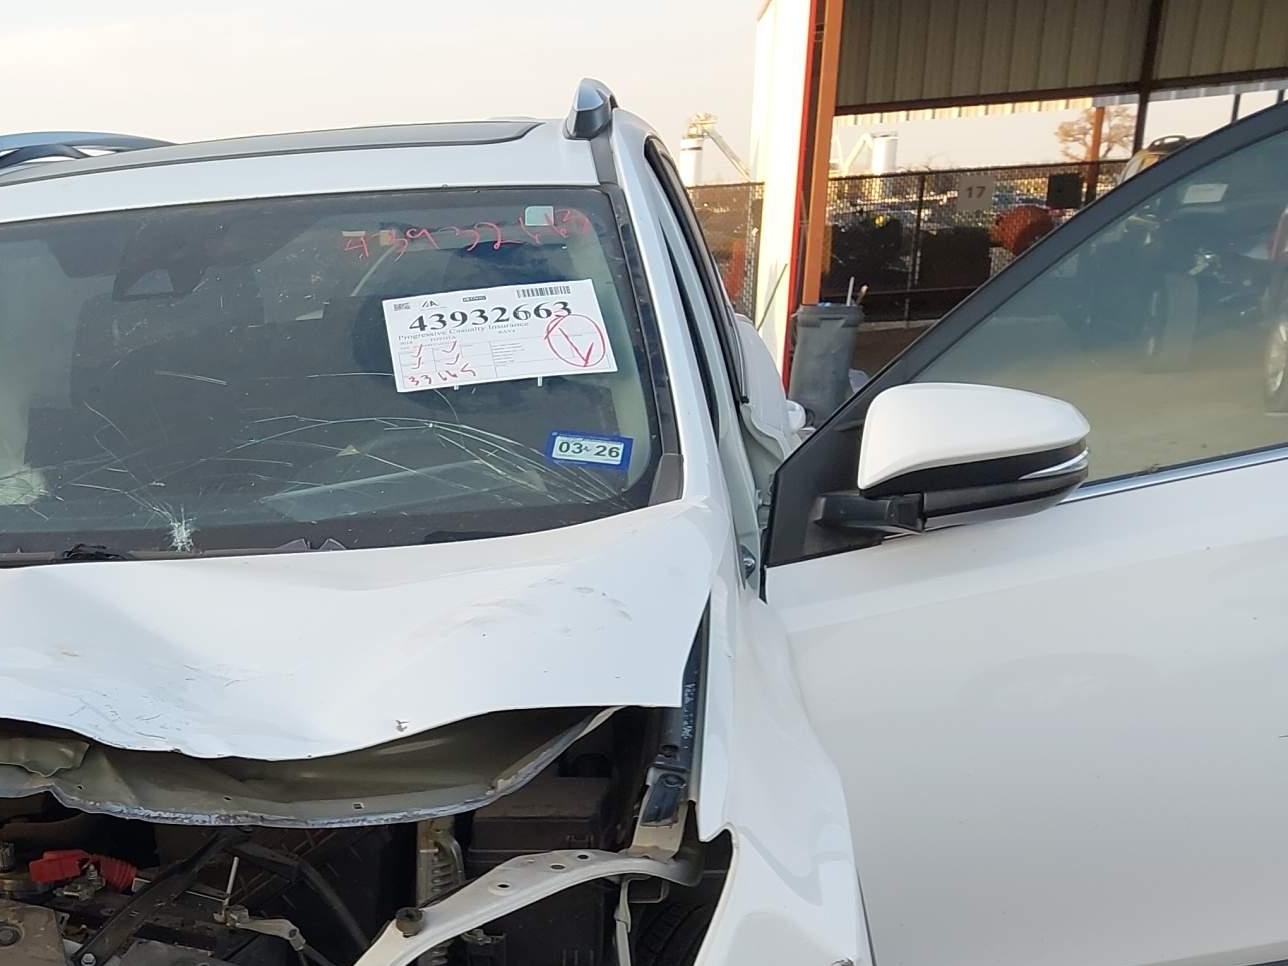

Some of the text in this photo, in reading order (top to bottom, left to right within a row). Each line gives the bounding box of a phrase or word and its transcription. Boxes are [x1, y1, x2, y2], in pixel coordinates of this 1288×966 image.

[967, 186, 986, 198] 17
[408, 301, 572, 332] 43932663
[558, 441, 620, 458] 03 26
